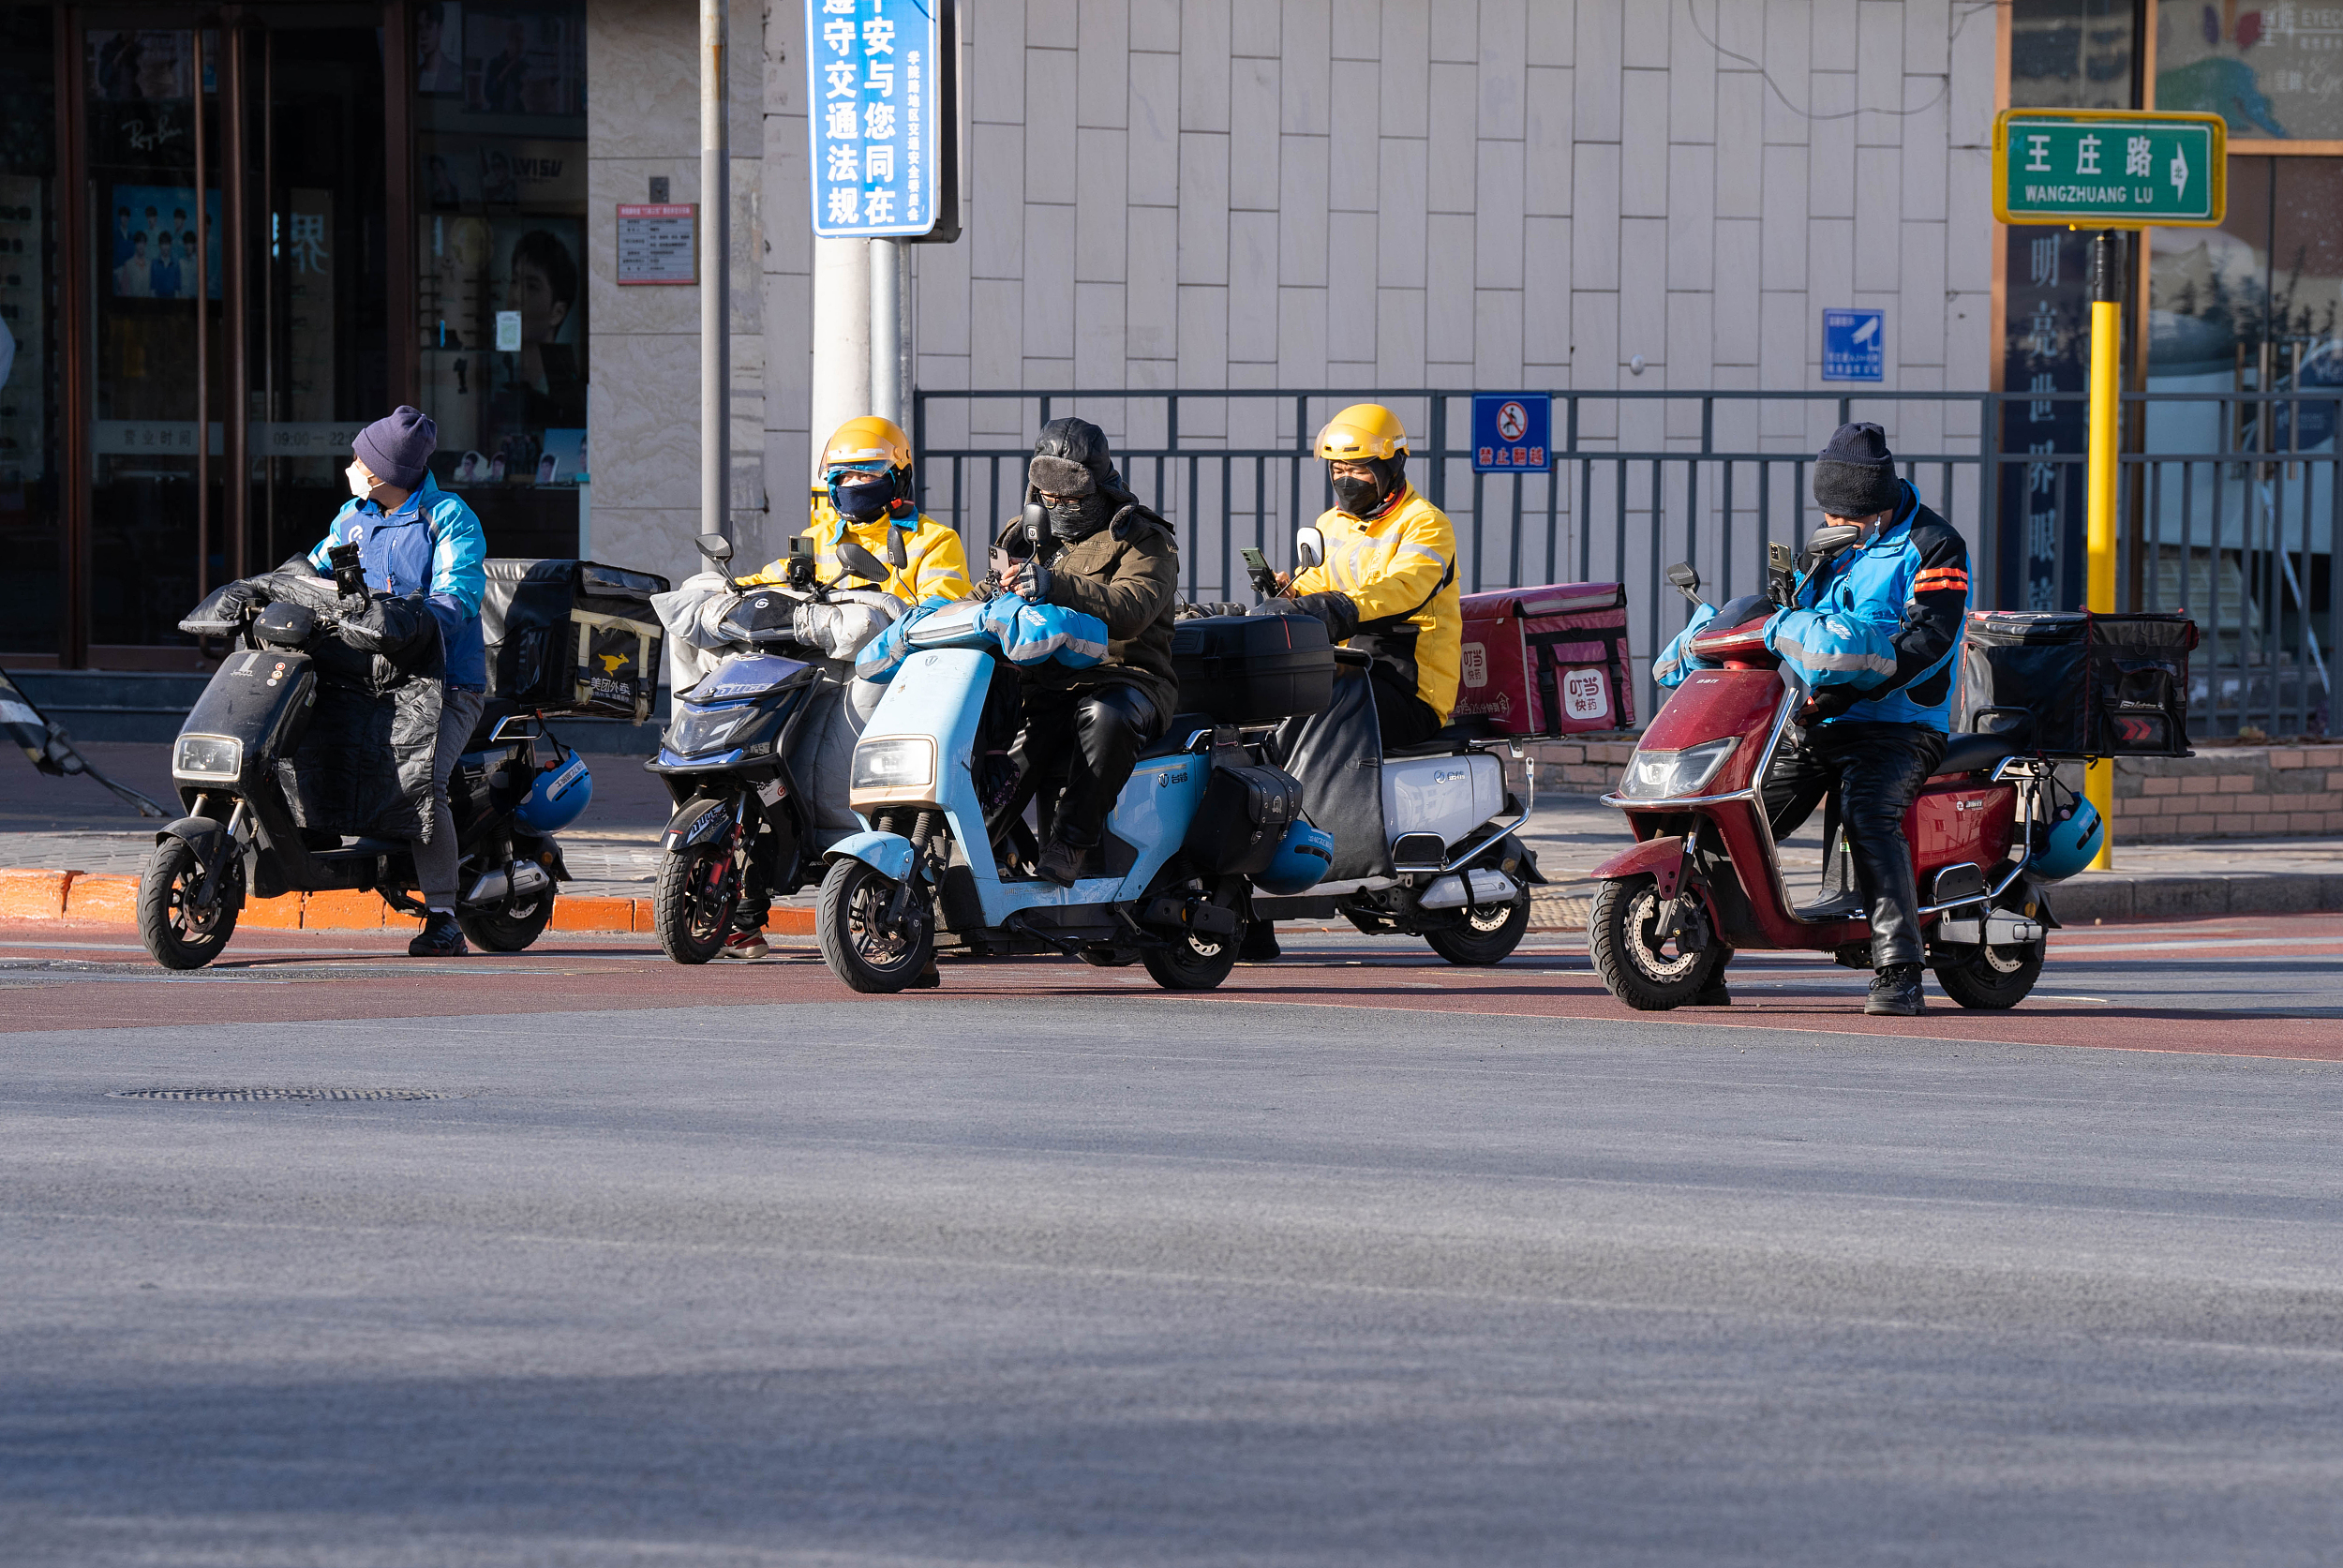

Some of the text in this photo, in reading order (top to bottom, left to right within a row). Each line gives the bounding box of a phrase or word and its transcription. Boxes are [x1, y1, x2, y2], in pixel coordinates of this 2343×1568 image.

[906, 51, 920, 221] 学院路地区交通安全委员会
[2024, 134, 2153, 177] 王庄路
[2024, 185, 2154, 203] WANGZHUANG LU
[124, 428, 191, 447] 营业时间
[273, 430, 310, 447] 09:00
[328, 430, 358, 447] 22:0
[1463, 650, 1484, 667] 叮当
[1468, 668, 1482, 680] 快药
[590, 677, 631, 696] 美团外卖
[1569, 677, 1600, 697] 叮当
[1574, 698, 1597, 712] 快药
